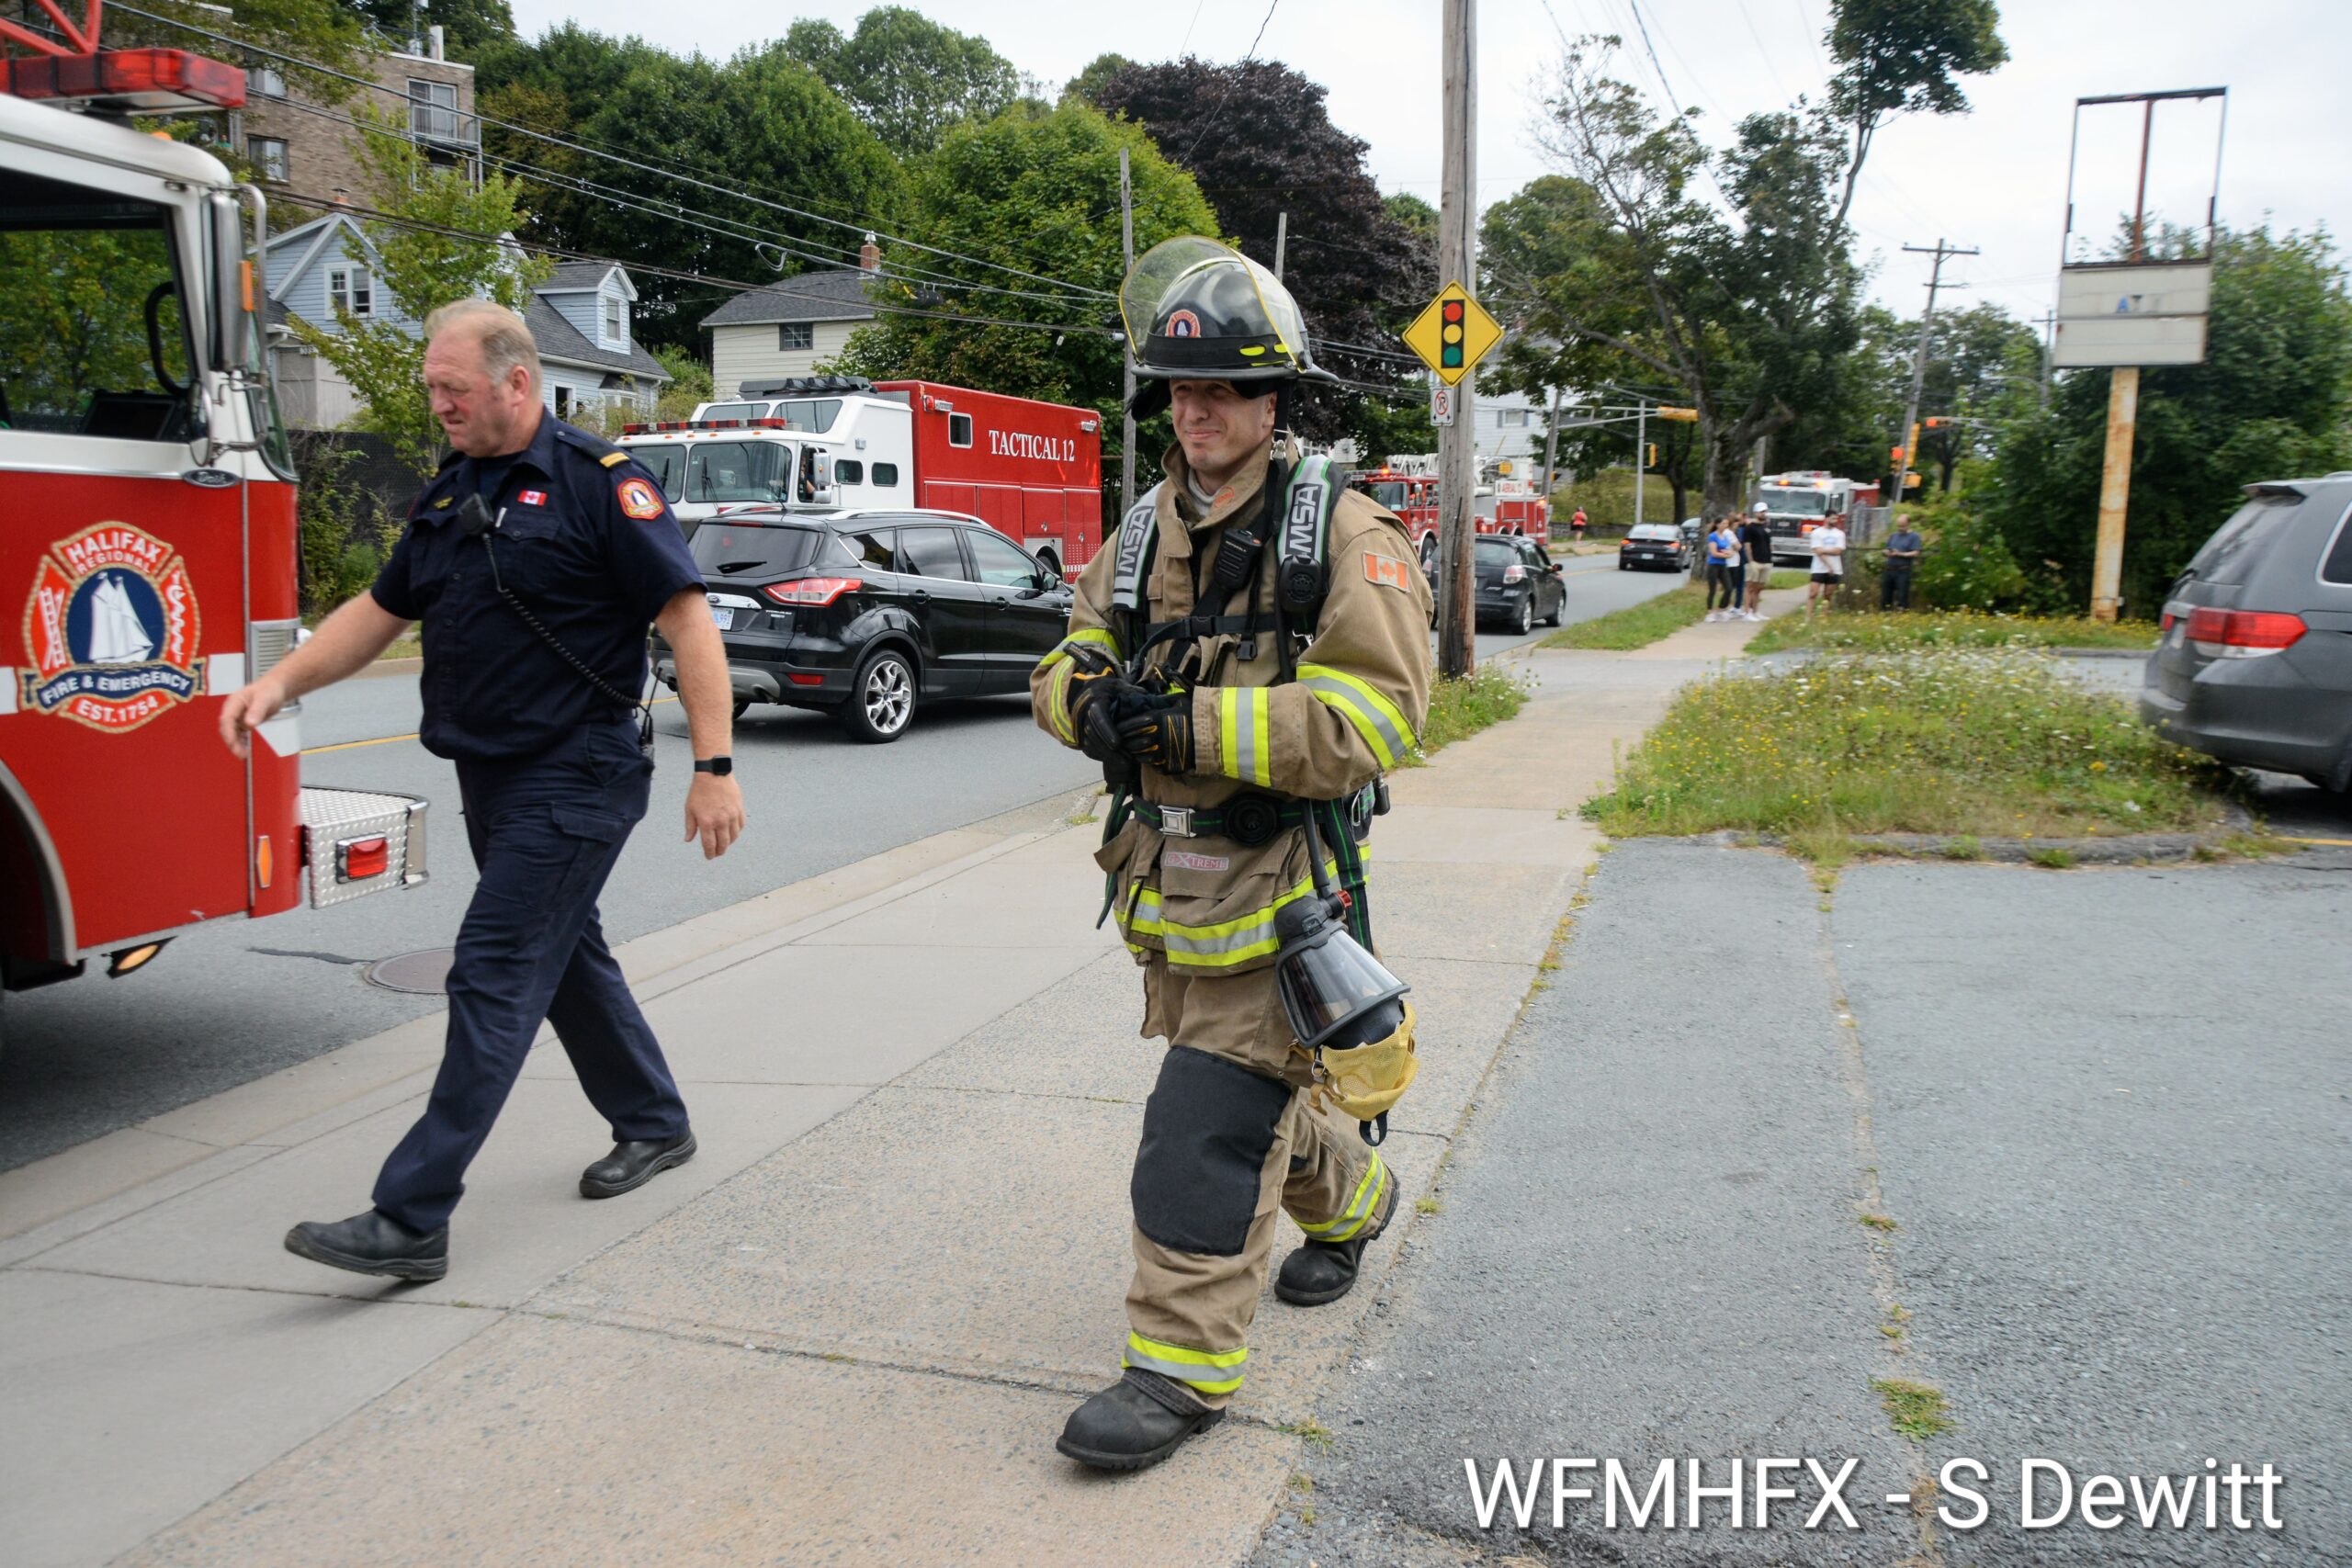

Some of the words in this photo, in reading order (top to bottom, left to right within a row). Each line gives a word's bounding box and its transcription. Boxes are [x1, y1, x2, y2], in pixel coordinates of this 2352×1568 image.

[989, 429, 1060, 460] TACTICAL
[1062, 439, 1075, 462] 12
[1290, 485, 1319, 553] MSA
[67, 531, 162, 563] HALIFAX
[1118, 508, 1149, 573] MSA
[75, 550, 153, 576] REGIONAL
[41, 677, 79, 705] FIRE
[82, 675, 95, 689] &
[96, 671, 191, 692] EMERGENCY
[77, 695, 159, 722] EST.1754
